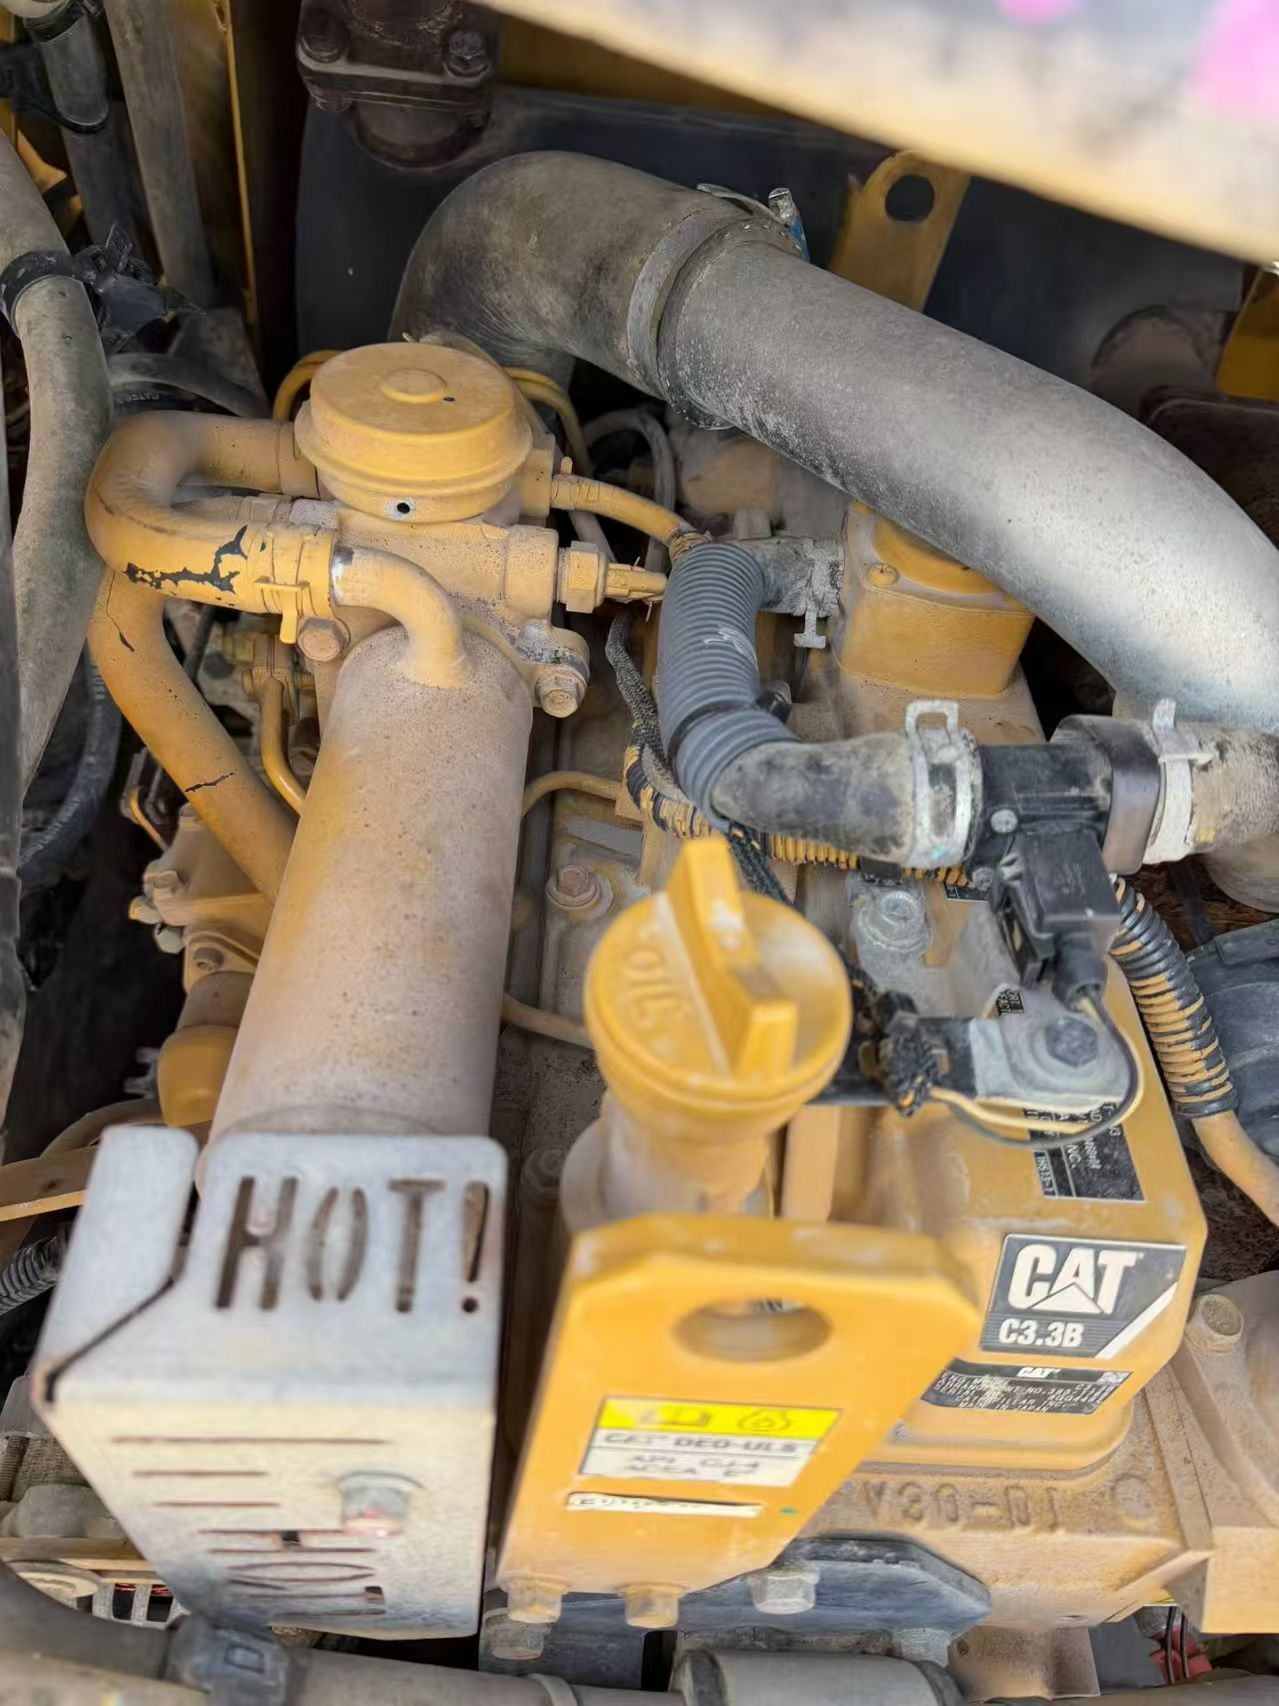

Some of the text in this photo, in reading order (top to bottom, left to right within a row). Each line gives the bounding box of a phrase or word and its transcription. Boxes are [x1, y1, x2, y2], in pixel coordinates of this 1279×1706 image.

[623, 944, 682, 1030] OIL
[213, 1175, 491, 1314] HOT!
[1008, 1243, 1138, 1315] CAT
[999, 1318, 1085, 1348] C3.3B
[1016, 1366, 1057, 1379] CAT
